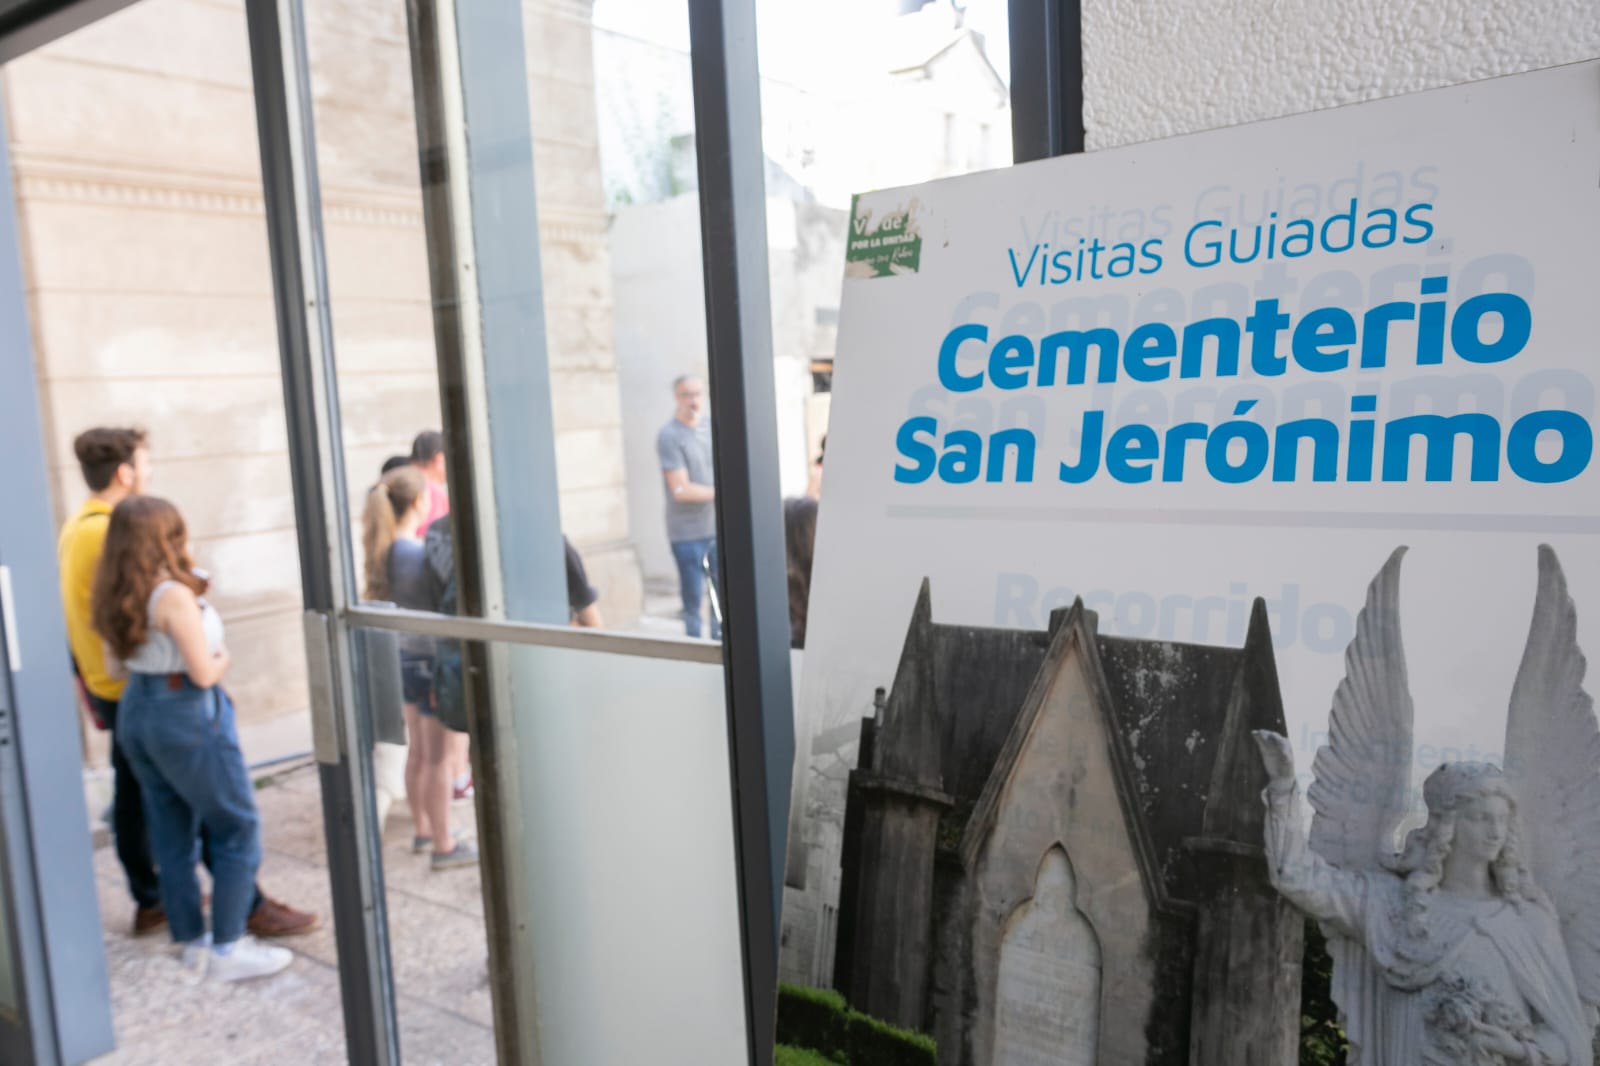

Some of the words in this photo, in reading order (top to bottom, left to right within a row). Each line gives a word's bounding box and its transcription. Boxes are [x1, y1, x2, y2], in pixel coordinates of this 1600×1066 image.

[1008, 237, 1164, 289] Visitas
[1183, 197, 1435, 270] Guiadas
[937, 275, 1534, 393] Cementerio
[893, 415, 1038, 485] San
[1058, 394, 1594, 485] Jerónimo
